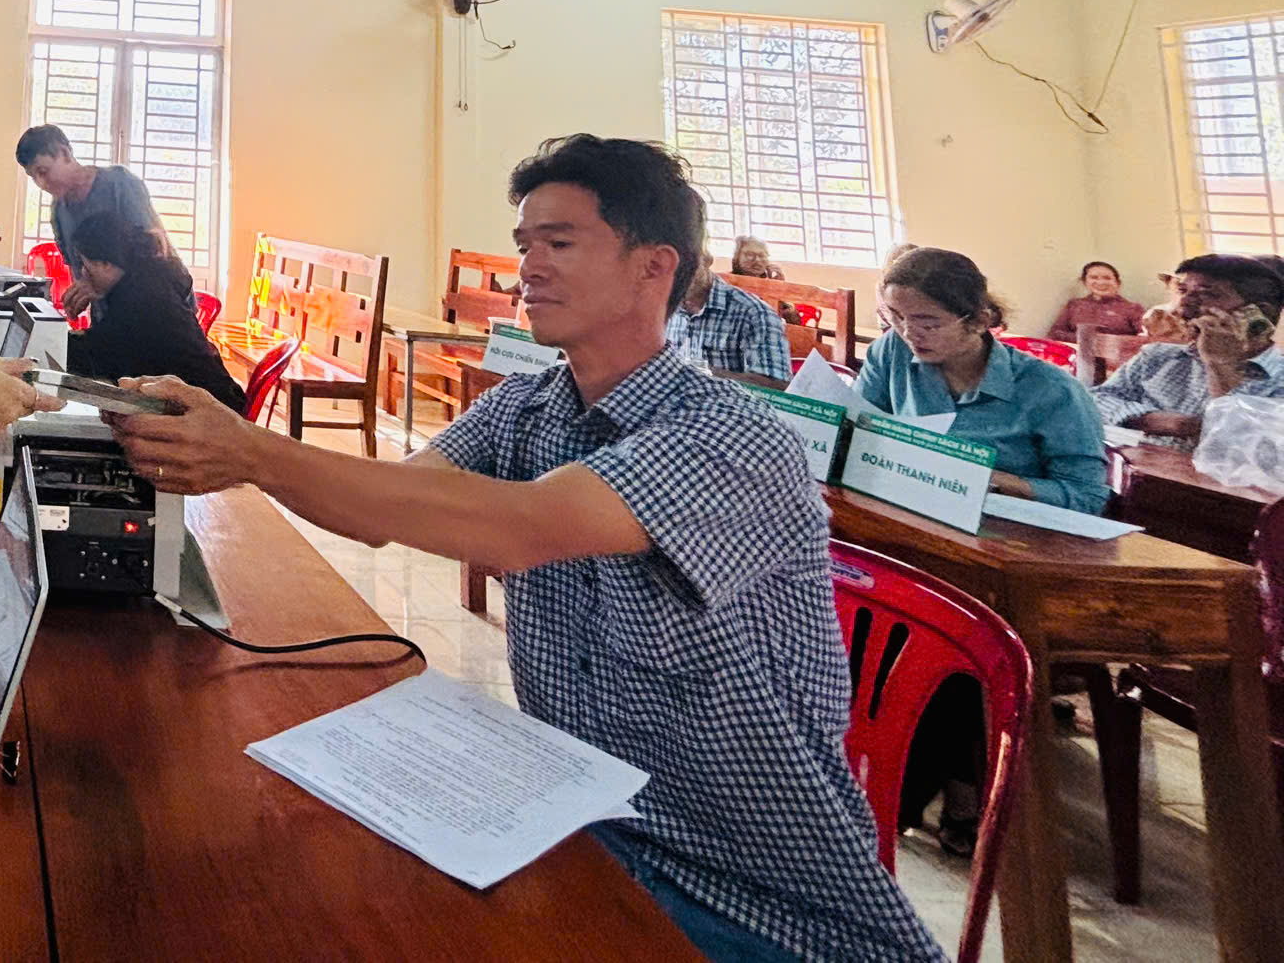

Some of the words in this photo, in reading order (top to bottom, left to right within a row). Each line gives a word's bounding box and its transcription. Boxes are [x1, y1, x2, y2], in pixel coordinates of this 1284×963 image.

[861, 452, 894, 472] ĐOÀN
[897, 463, 936, 486] THANH
[938, 479, 968, 496] NIÊN
